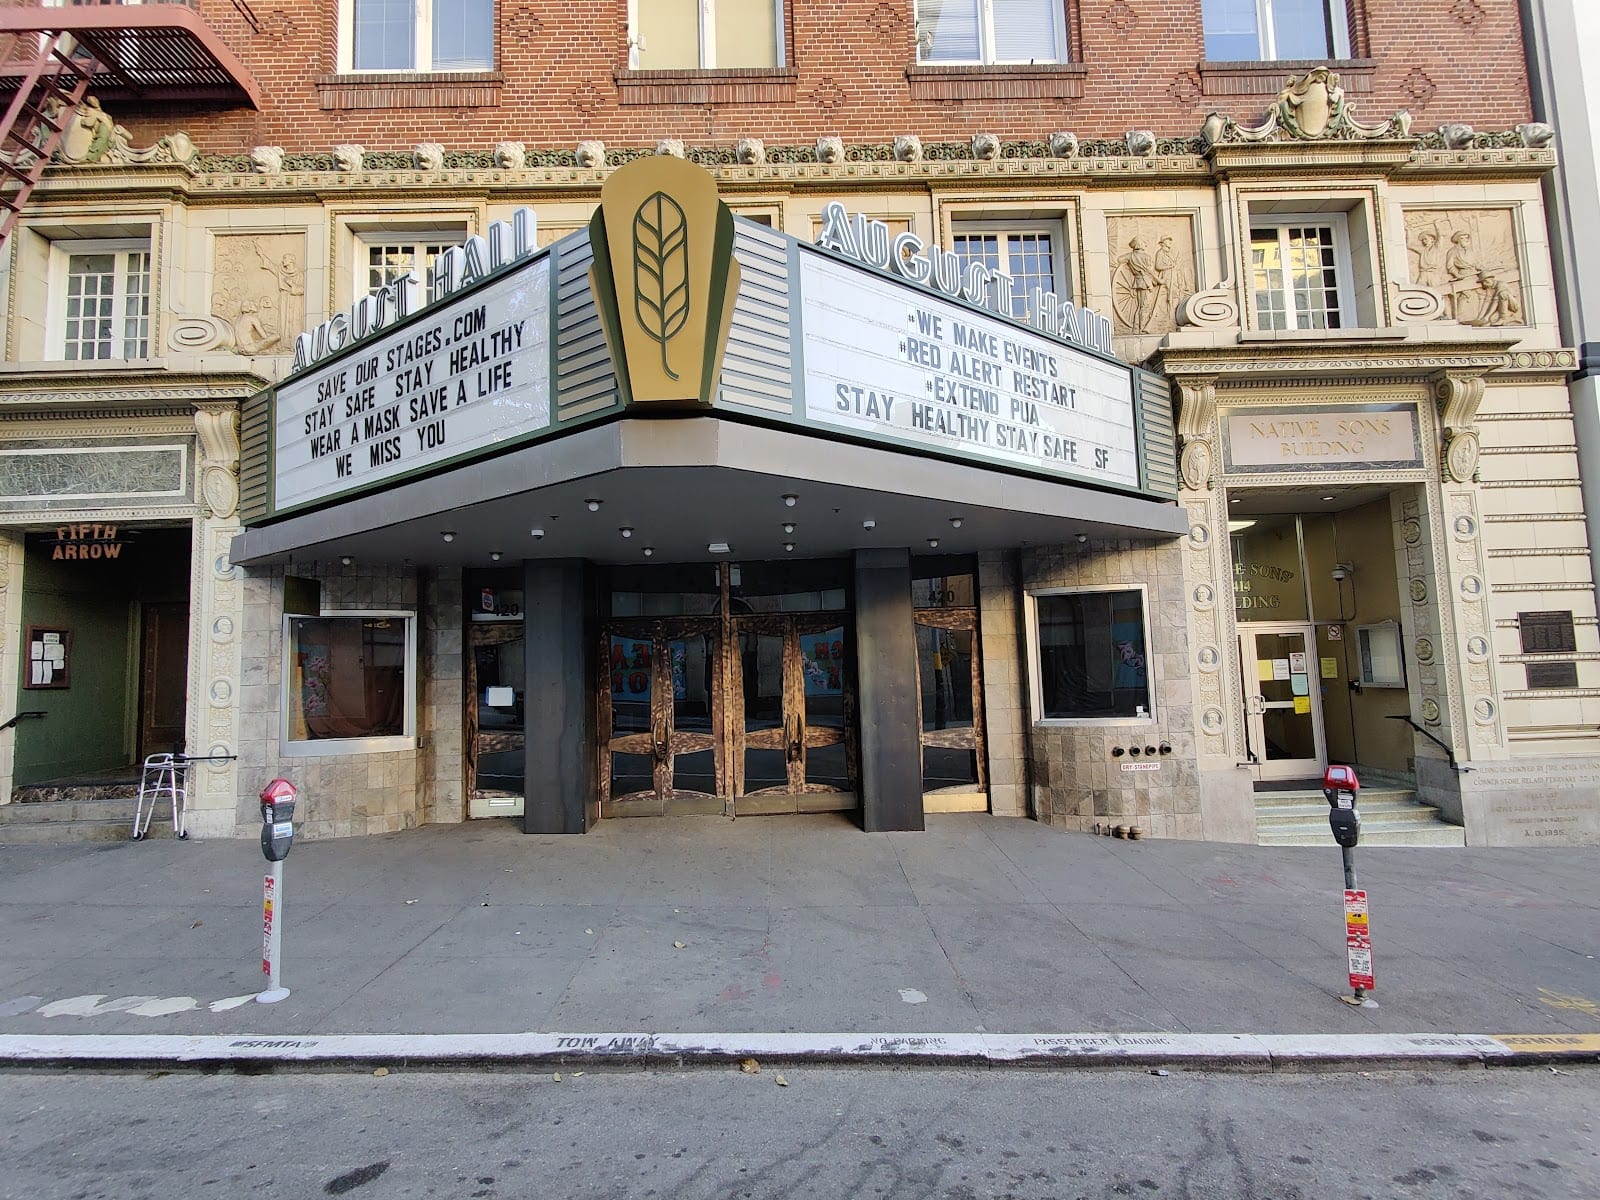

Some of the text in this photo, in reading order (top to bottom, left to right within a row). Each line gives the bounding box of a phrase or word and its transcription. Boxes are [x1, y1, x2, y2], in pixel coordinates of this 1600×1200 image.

[291, 207, 538, 373] AUGUST HALL
[819, 201, 1116, 357] AUGUST HALL
[317, 305, 486, 404] SAVE OUR STAGES.COM
[908, 310, 1058, 378] #WE MAKE EVENTS
[305, 320, 525, 435] STAY SAFE STAY HEALTHY
[900, 337, 1076, 409] #RED ALERT RESTART
[310, 361, 512, 459] WEAR A MASK SAVE A LIFE
[836, 384, 1109, 469] STAY HEALTHY STAY SAFE SF
[926, 377, 1040, 427] #EXTEND PUA
[1249, 418, 1392, 439] NATIVE SONS
[336, 420, 446, 479] WE MISS YOU
[1280, 440, 1365, 457] BUILDING
[52, 543, 122, 560] ARROW
[56, 524, 118, 540] FIFTH
[243, 1040, 302, 1048] SFMTA
[557, 1036, 660, 1048] TOW AWAY
[871, 1037, 947, 1045] NO PARKING
[1114, 1037, 1171, 1045] LOADING
